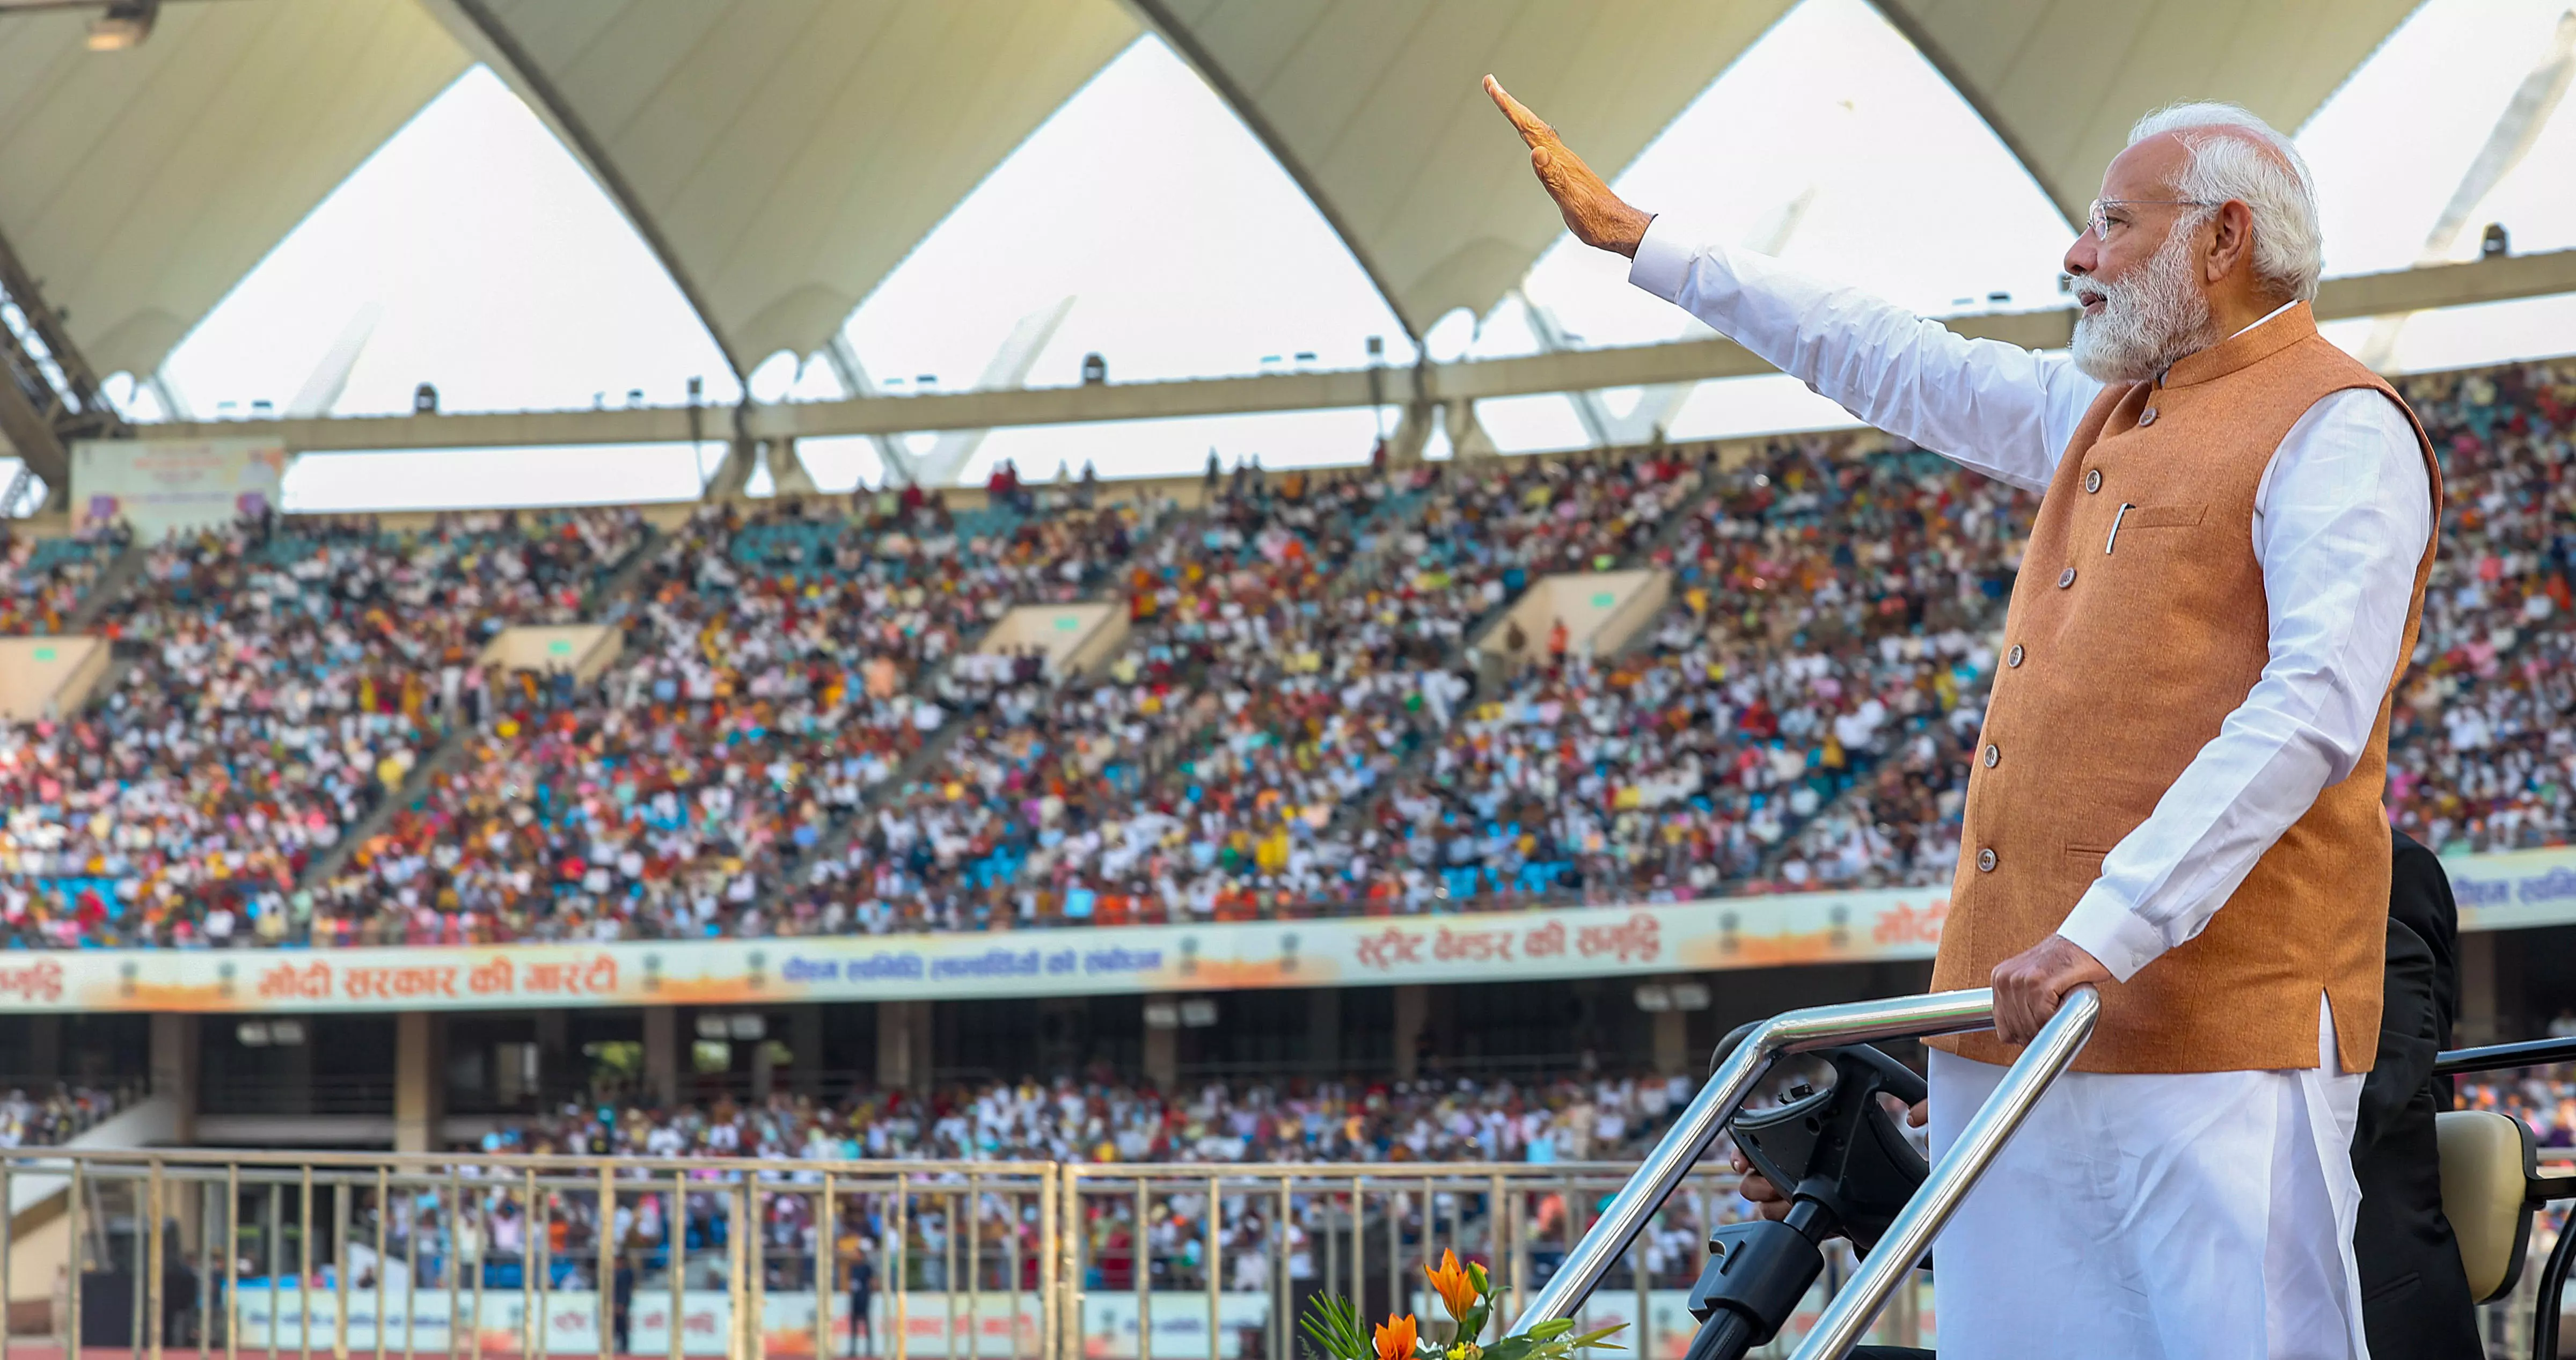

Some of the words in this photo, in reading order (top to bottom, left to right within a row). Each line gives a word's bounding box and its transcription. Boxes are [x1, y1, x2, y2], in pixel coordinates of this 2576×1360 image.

[1525, 920, 1565, 957] की
[258, 960, 332, 998] मोदी
[343, 966, 457, 999] सरकार
[469, 955, 514, 994] की
